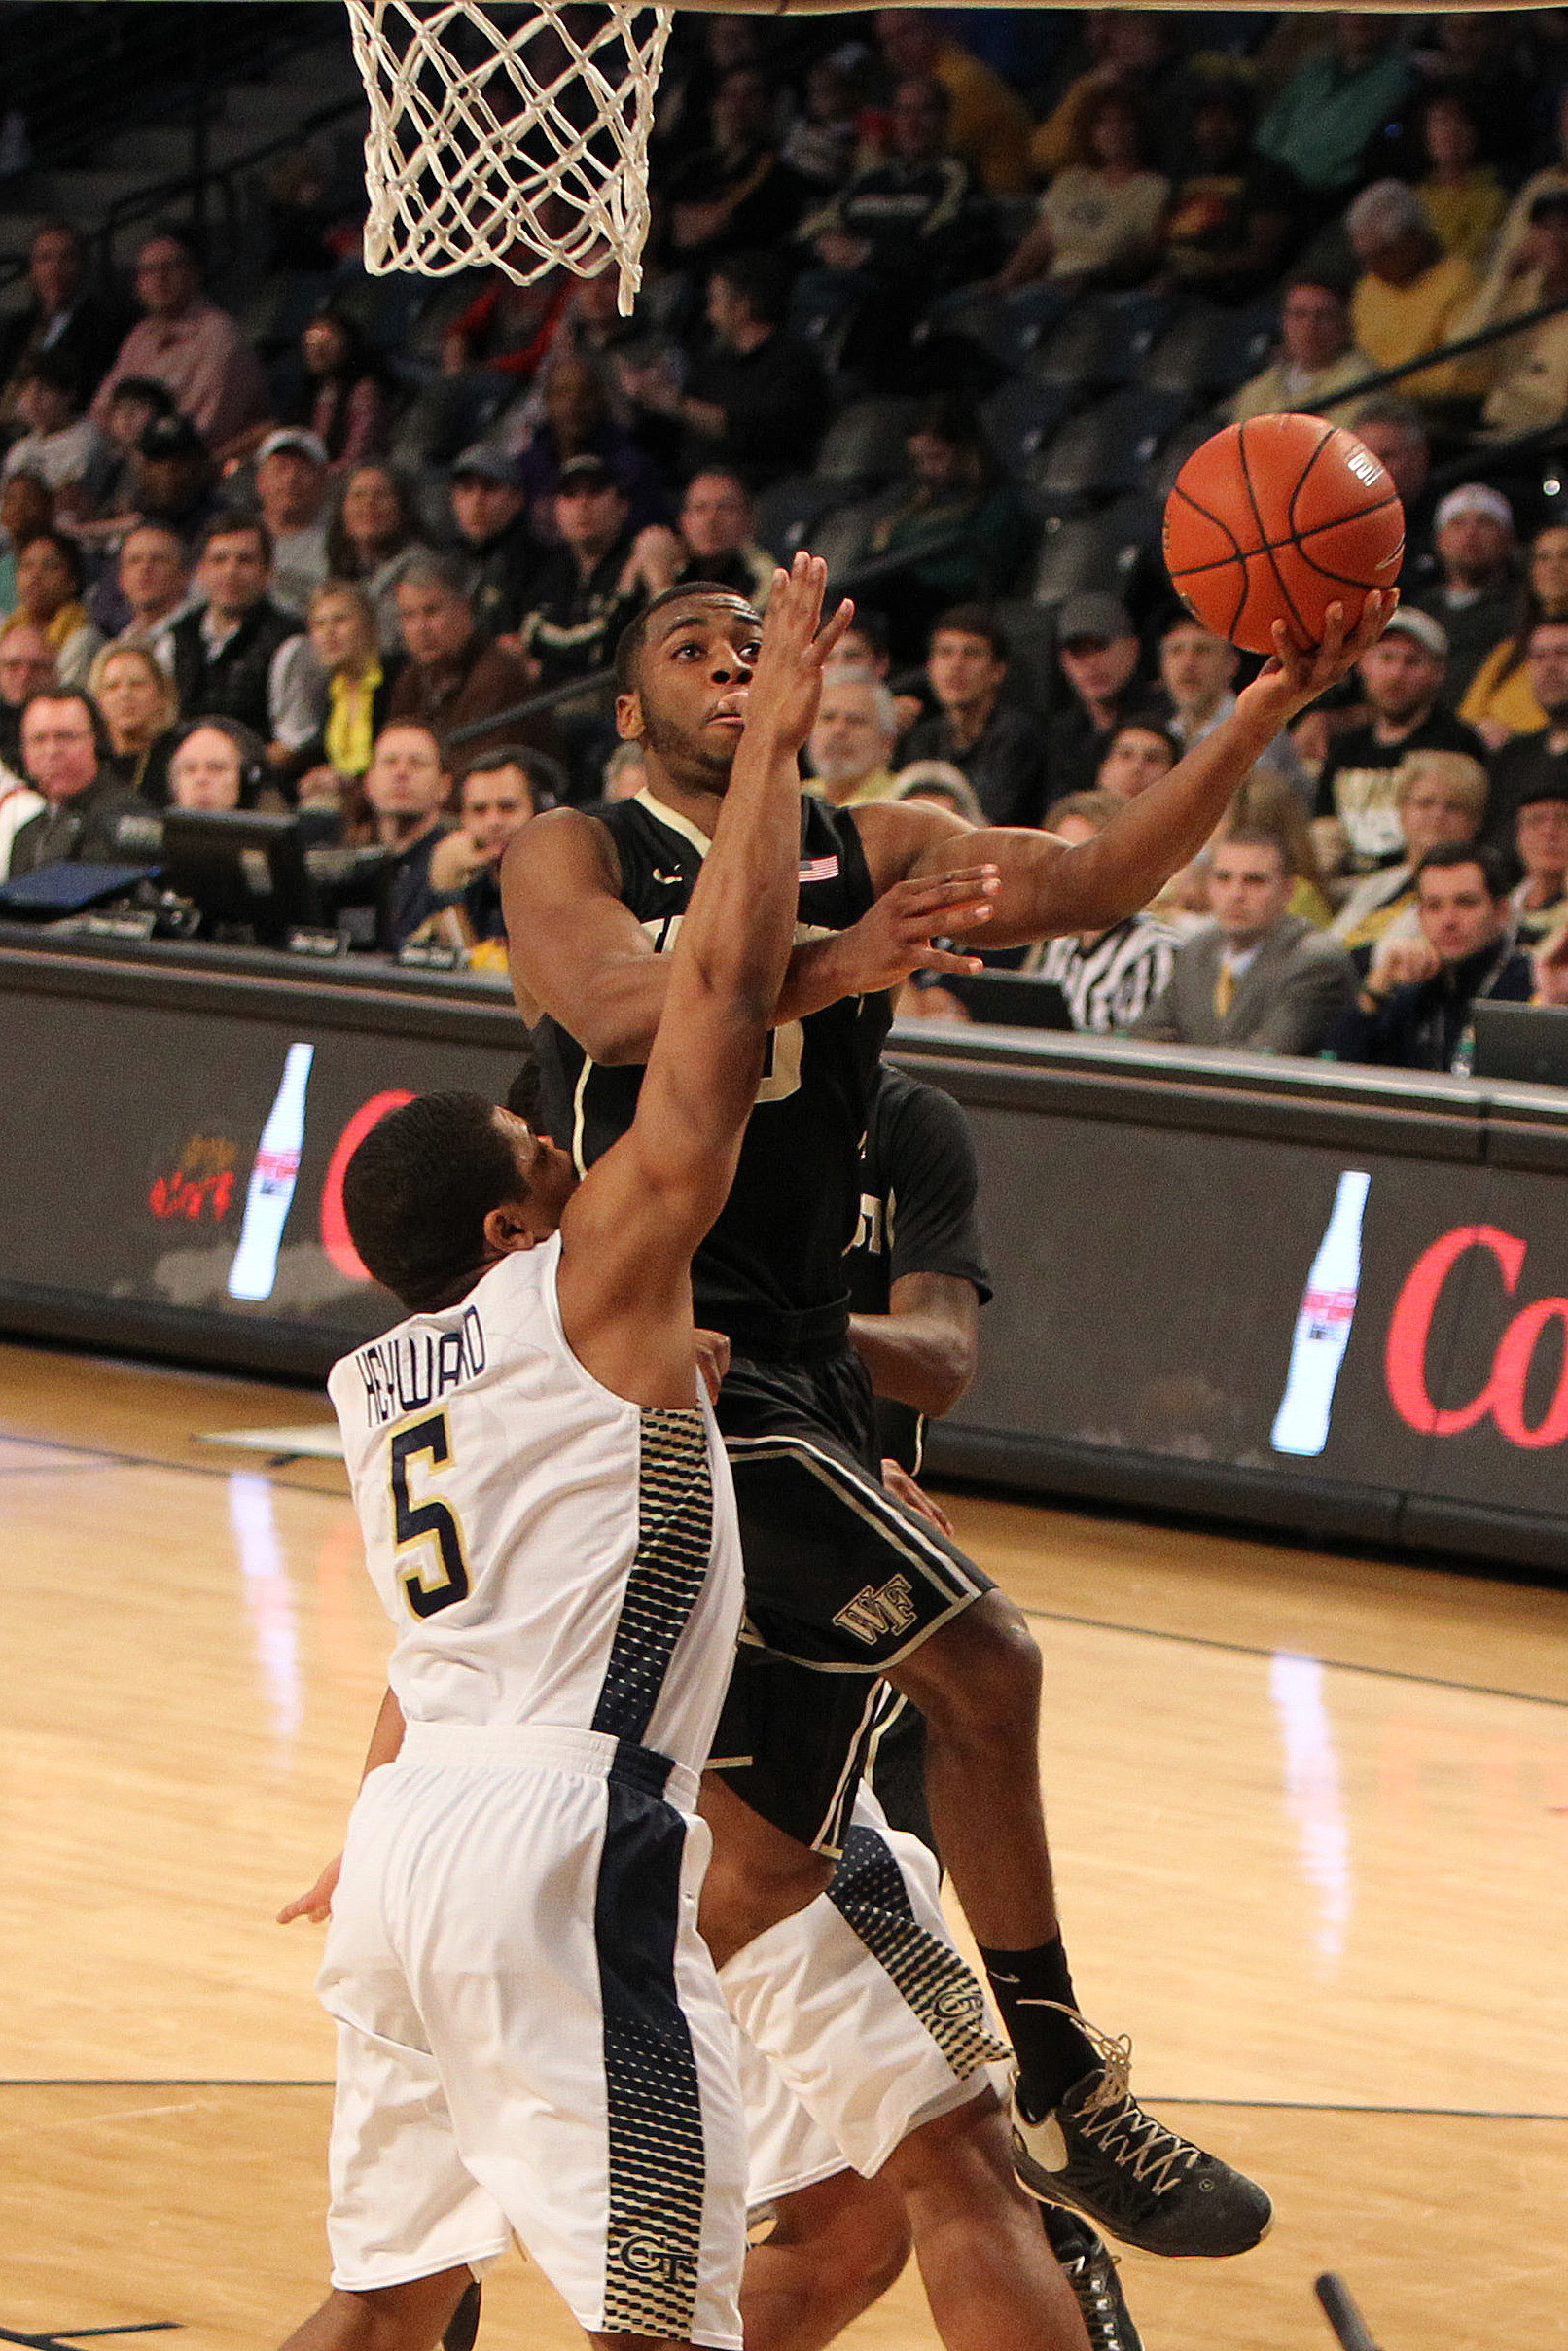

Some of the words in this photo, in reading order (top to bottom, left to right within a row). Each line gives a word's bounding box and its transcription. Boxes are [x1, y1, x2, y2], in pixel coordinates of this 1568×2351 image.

[390, 1402, 475, 1622] 5
[832, 1572, 918, 1646] WF
[621, 2235, 697, 2283] GT
